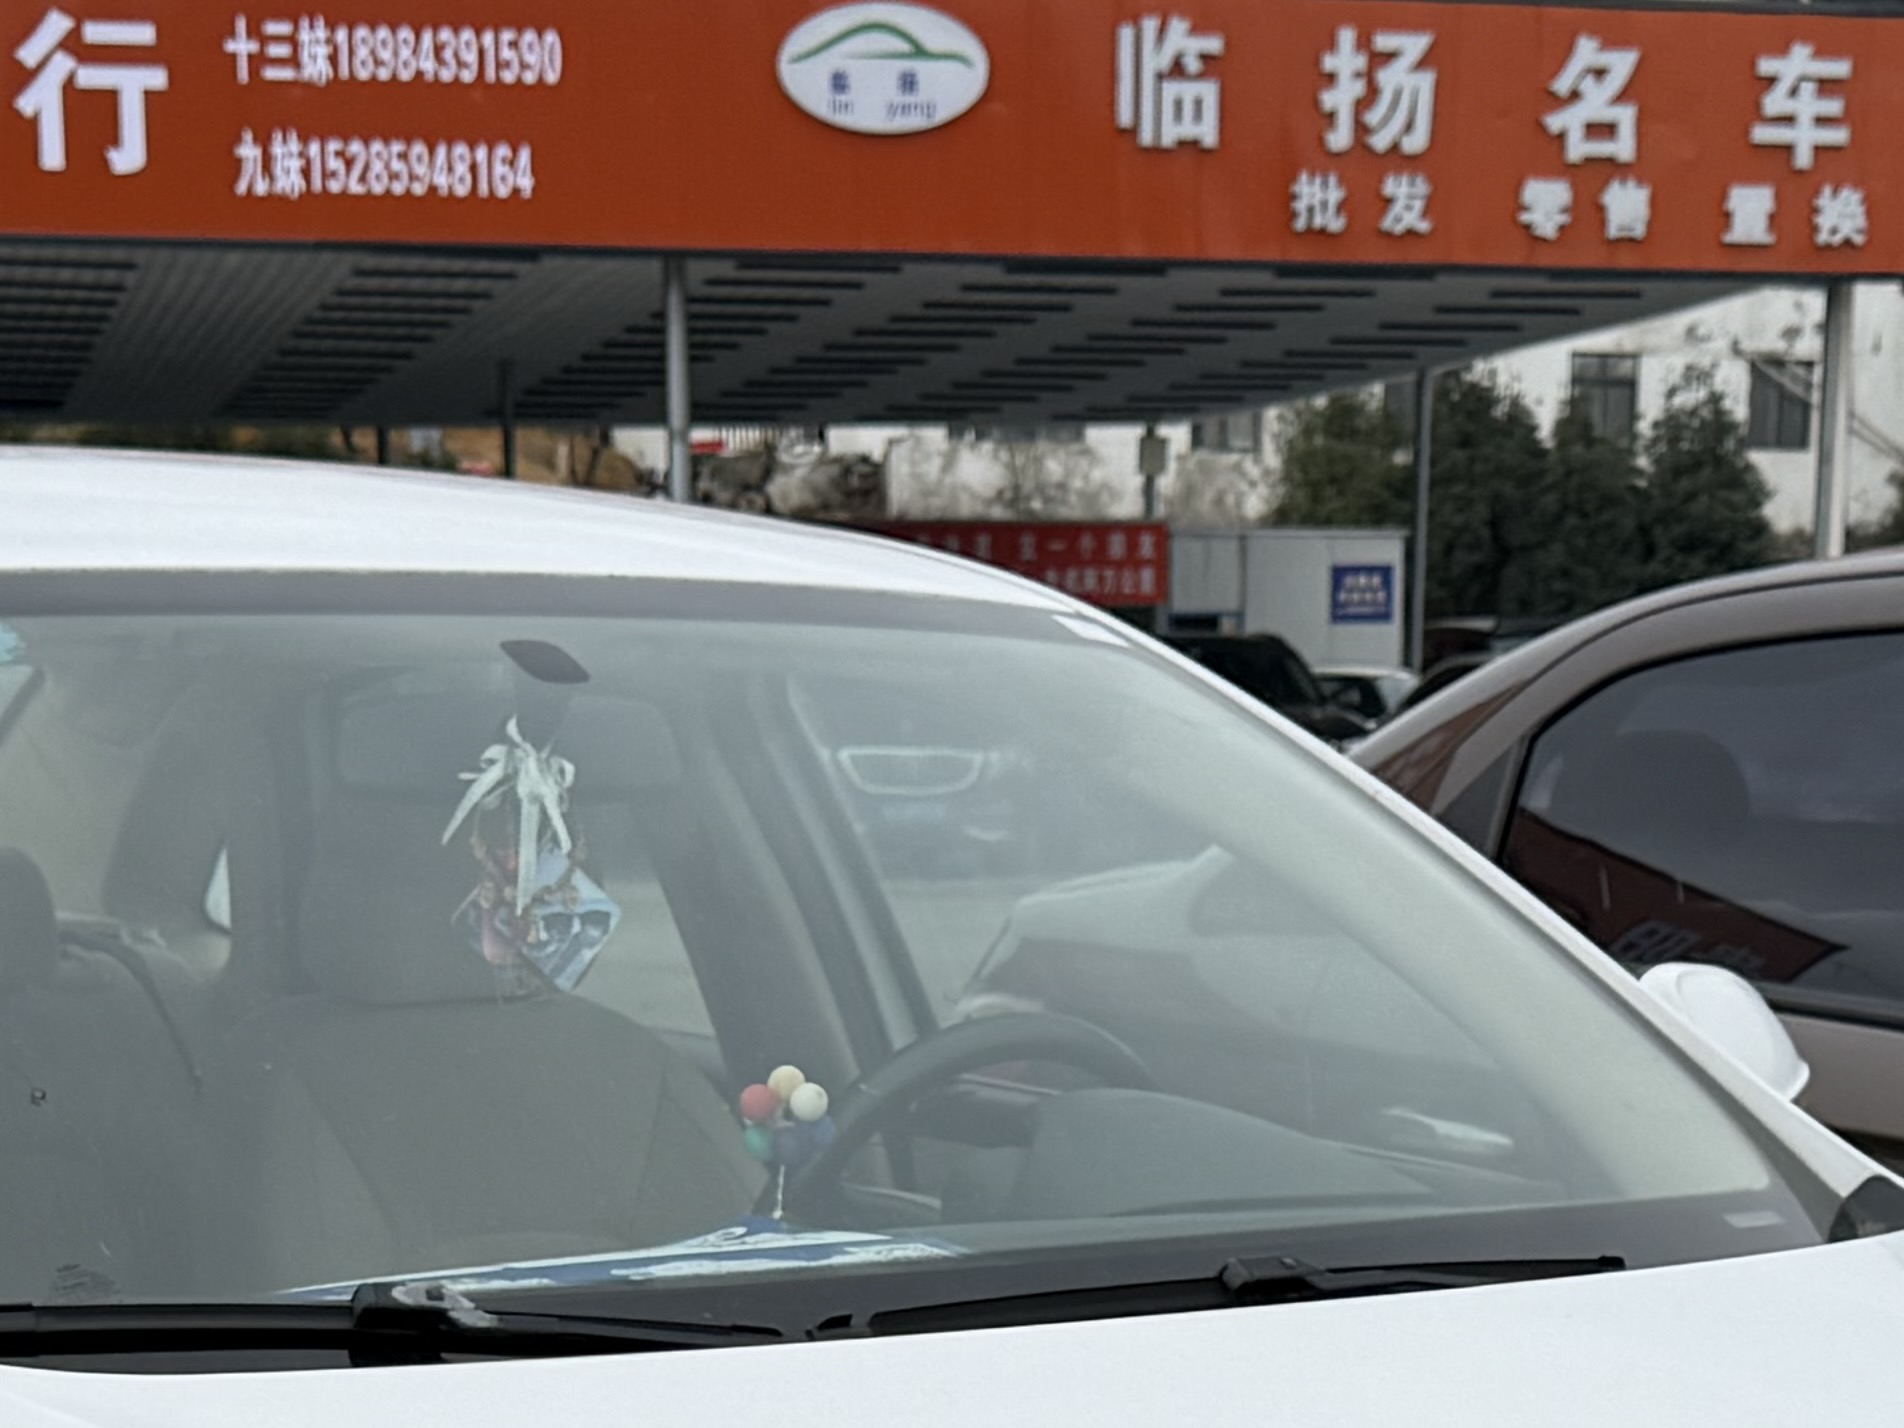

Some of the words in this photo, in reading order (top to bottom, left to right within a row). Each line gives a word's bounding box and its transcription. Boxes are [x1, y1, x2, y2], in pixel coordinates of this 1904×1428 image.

[1116, 14, 1854, 170] 临扬名车
[1291, 170, 1434, 235] 批发
[1518, 176, 1652, 240] 零售
[1721, 182, 1869, 246] 置换
